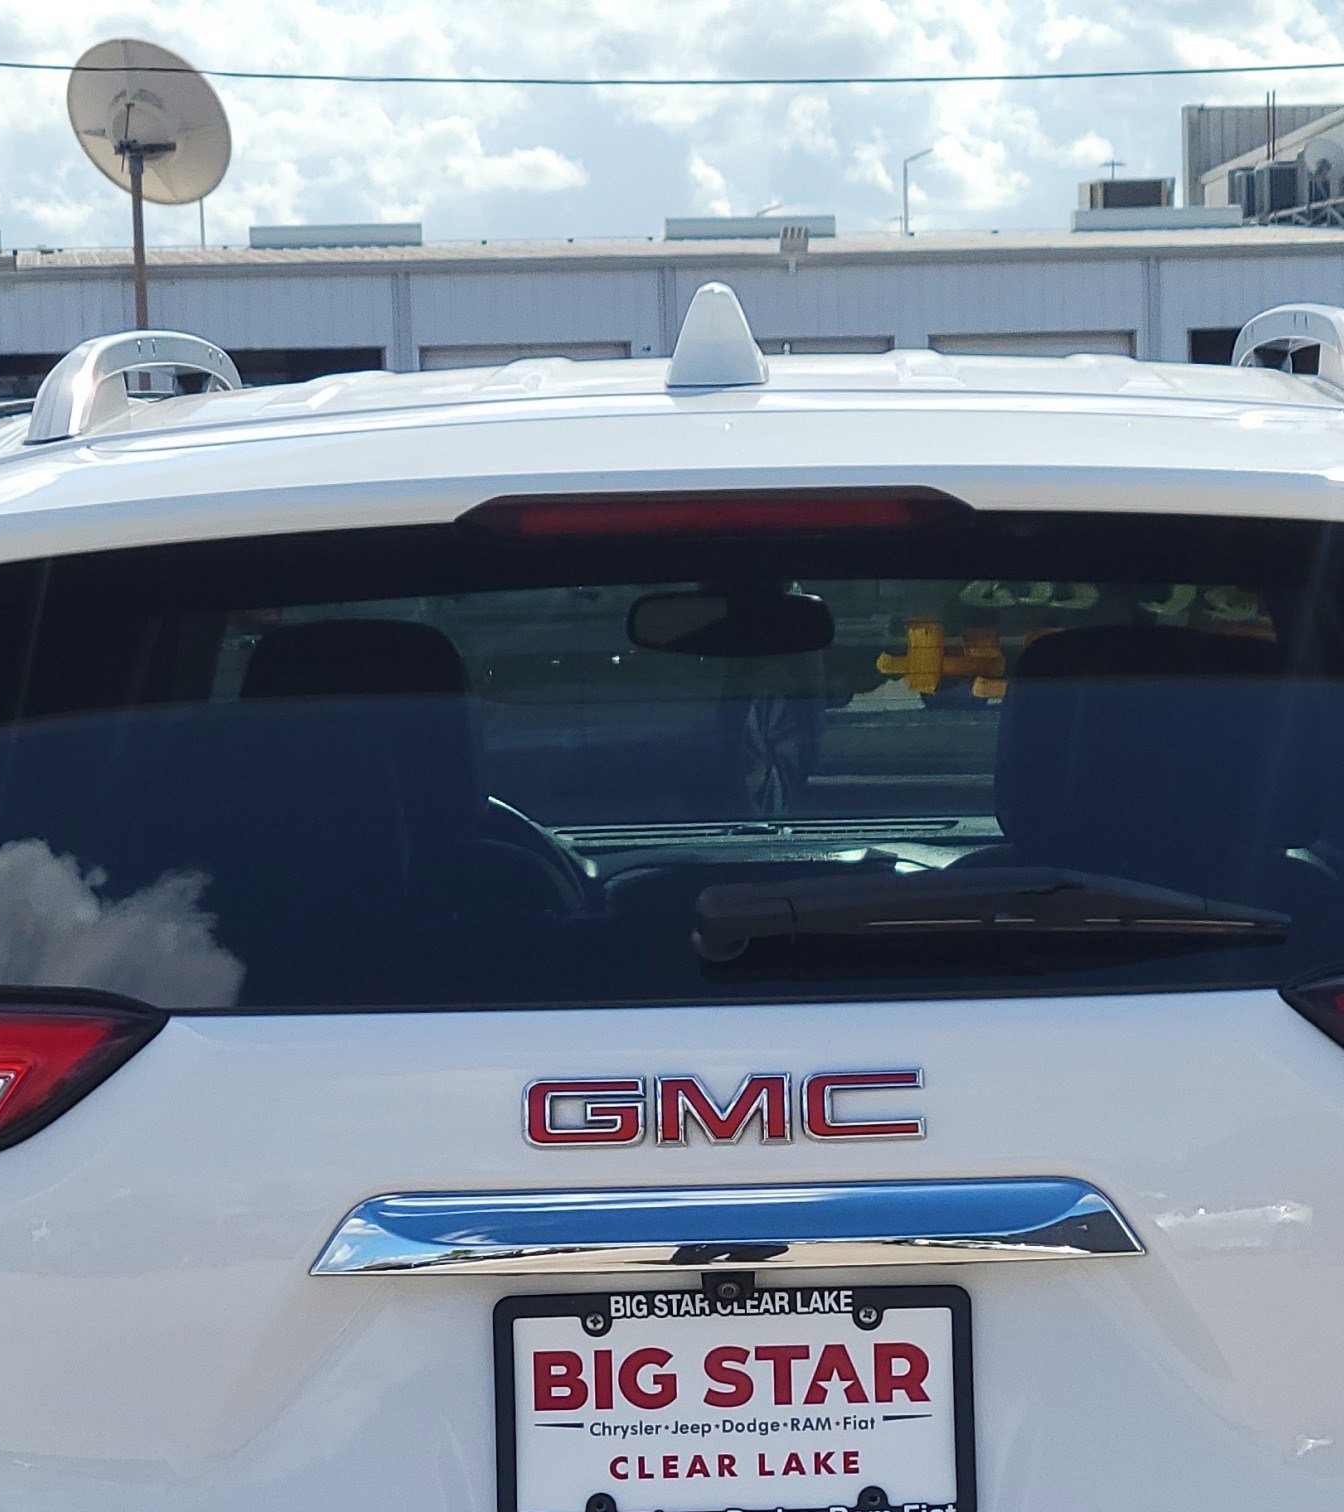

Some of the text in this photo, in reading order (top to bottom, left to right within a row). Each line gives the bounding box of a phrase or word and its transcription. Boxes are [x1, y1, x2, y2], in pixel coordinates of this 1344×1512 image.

[523, 1069, 926, 1147] GMC
[610, 1295, 648, 1317] BIG
[654, 1293, 710, 1316] STAR
[796, 1289, 854, 1313] LAKE
[532, 1342, 932, 1412] BIG STAR
[589, 1414, 876, 1439] Chrysler Jeep Dodge RAM Fiat
[609, 1450, 860, 1480] CLEAR LAKE
